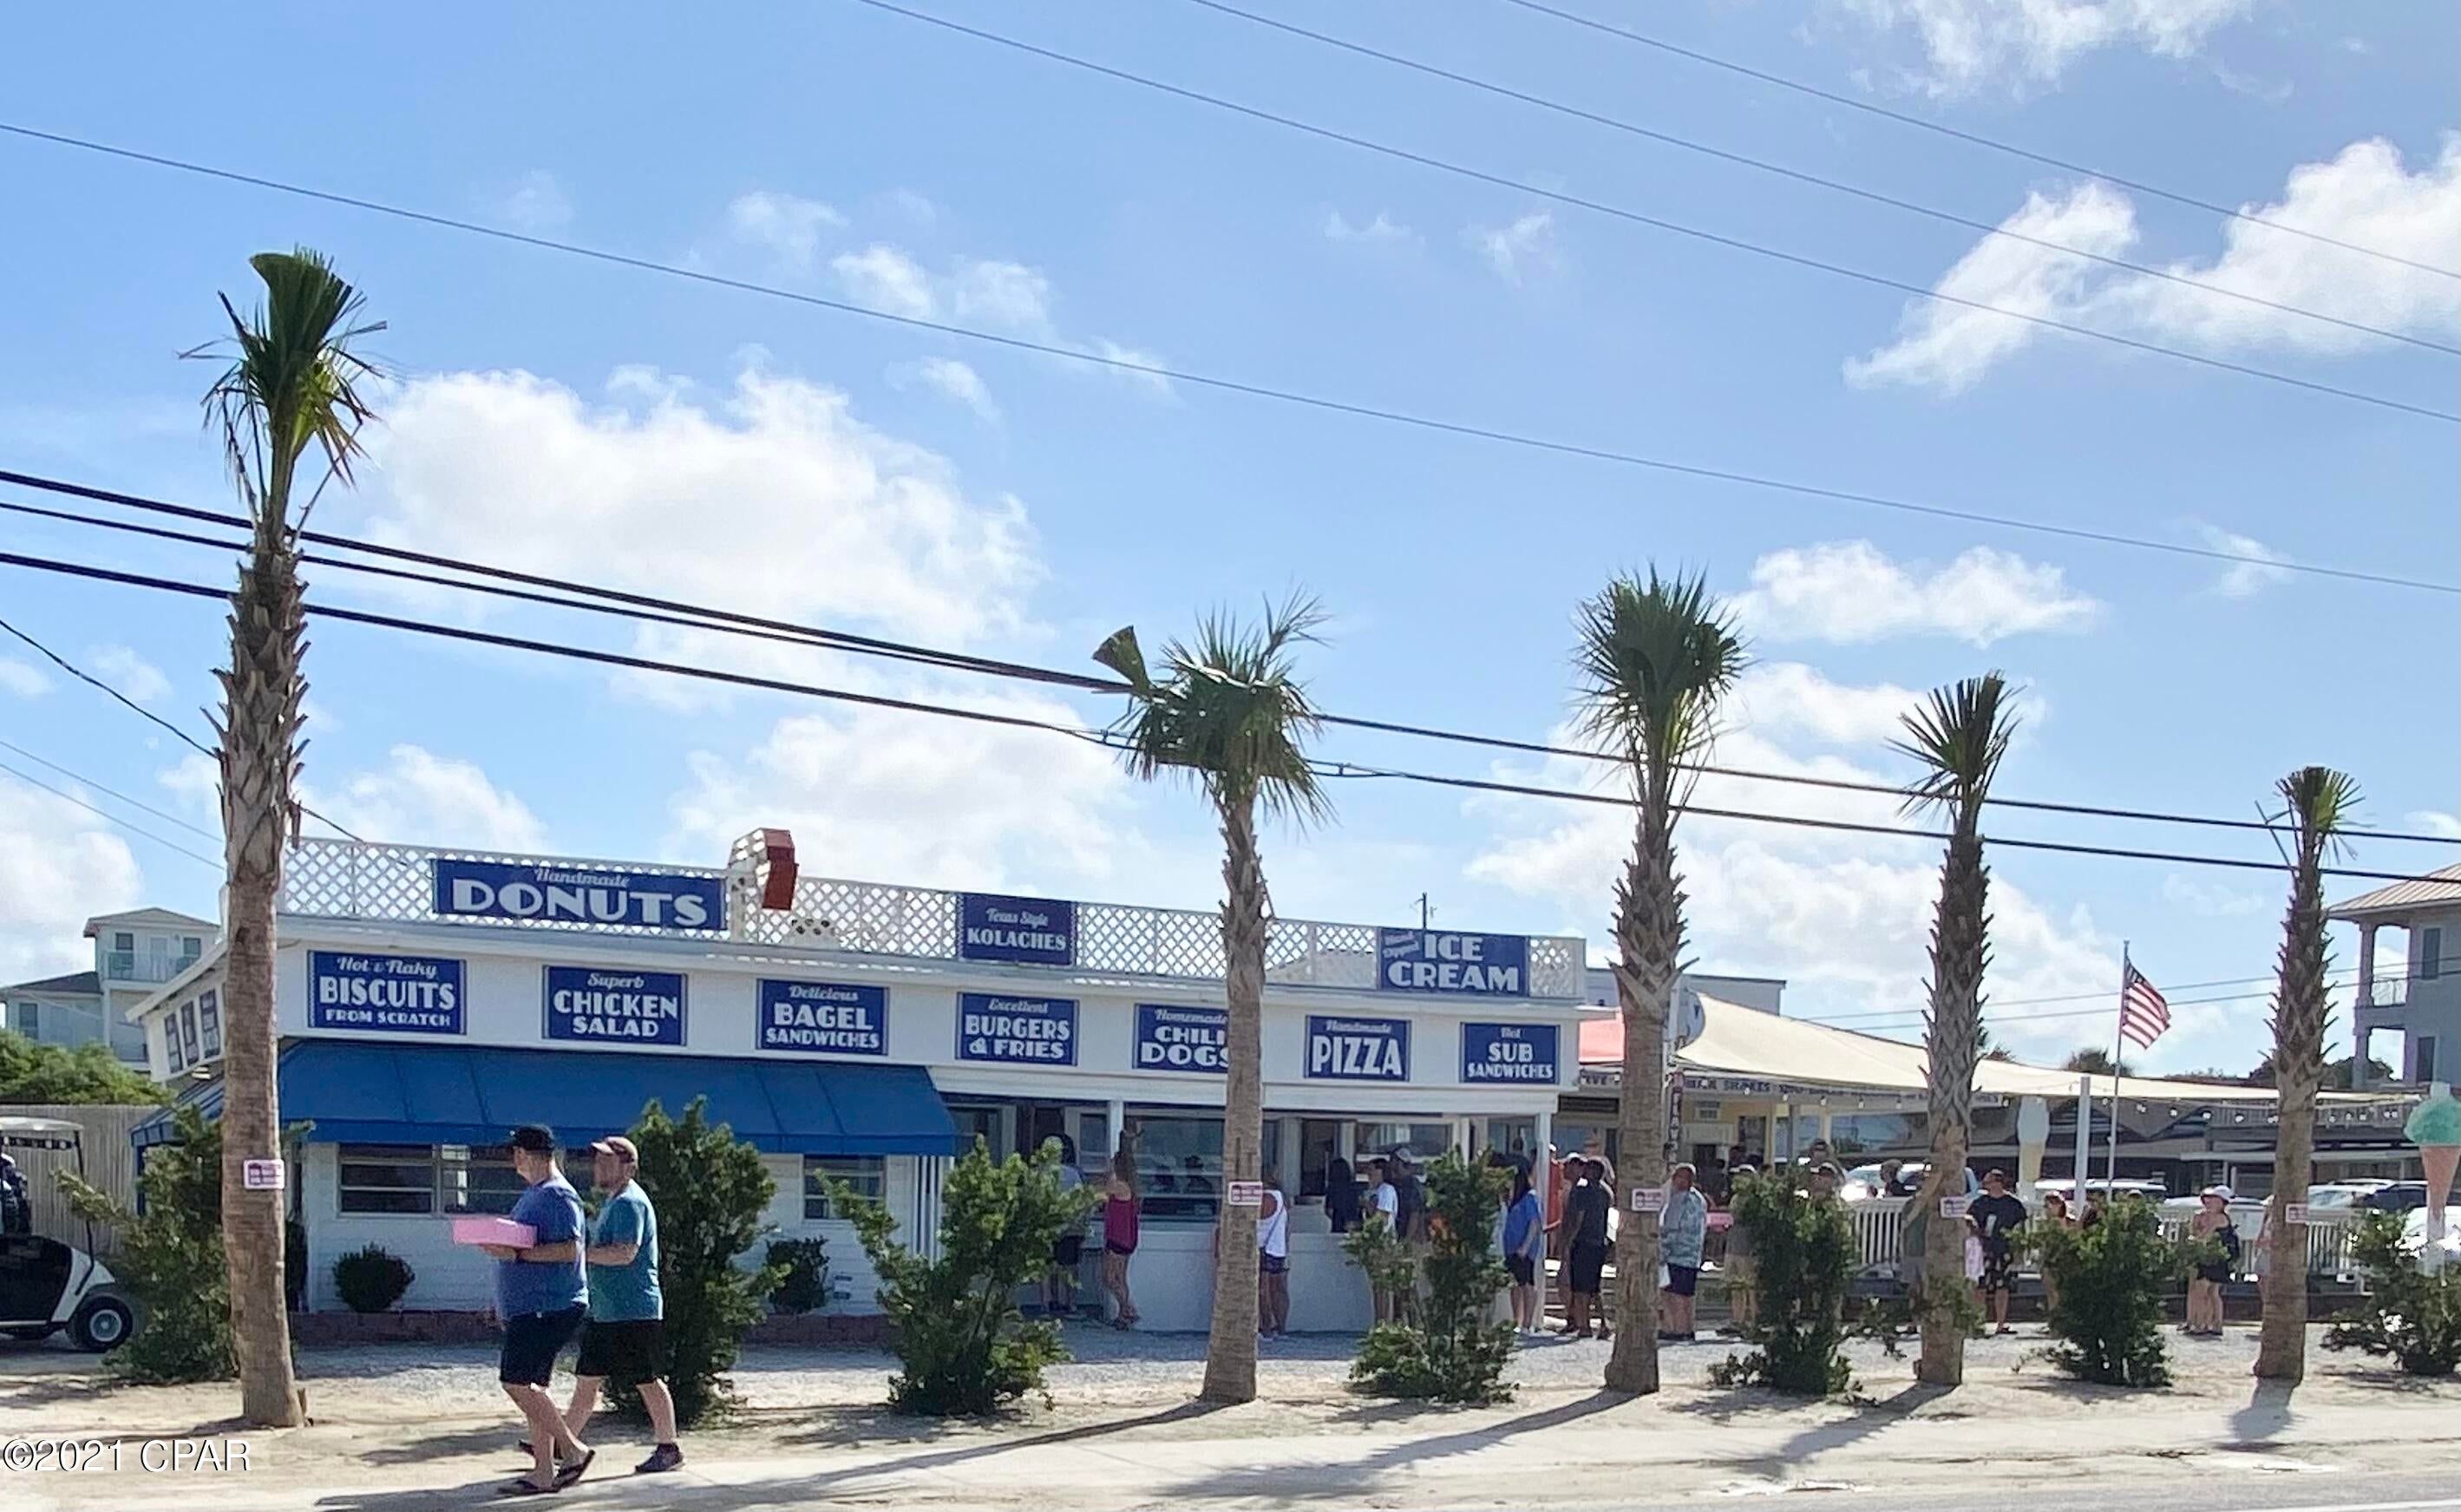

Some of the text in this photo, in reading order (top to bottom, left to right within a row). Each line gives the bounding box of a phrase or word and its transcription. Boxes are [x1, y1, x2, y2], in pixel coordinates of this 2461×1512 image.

[534, 867, 629, 887] Handmade
[452, 879, 708, 926] DONUTS
[985, 907, 1018, 923] Texas
[966, 927, 1067, 952] KOLACHES
[1424, 933, 1484, 961] ICE
[337, 957, 370, 972] Hot
[385, 959, 437, 979] Flaky
[1387, 960, 1519, 992] CREAM
[586, 972, 645, 990] Superb
[318, 975, 455, 1011] BISCUITS
[553, 989, 678, 1019] CHICKEN
[789, 985, 859, 1002] Delicious
[325, 1009, 451, 1026] FROM SCRATCH
[572, 1016, 659, 1037] SALAD
[773, 1001, 874, 1031] BAGEL
[766, 1027, 880, 1049] SANDWICHES
[965, 1014, 1070, 1041] BURGERS
[1155, 1025, 1226, 1045] CHILI
[969, 1037, 1064, 1058] & FRIES
[1312, 1035, 1403, 1076] PIZZA
[1488, 1042, 1534, 1063] SUB
[1467, 1062, 1554, 1078] SANDWICHES
